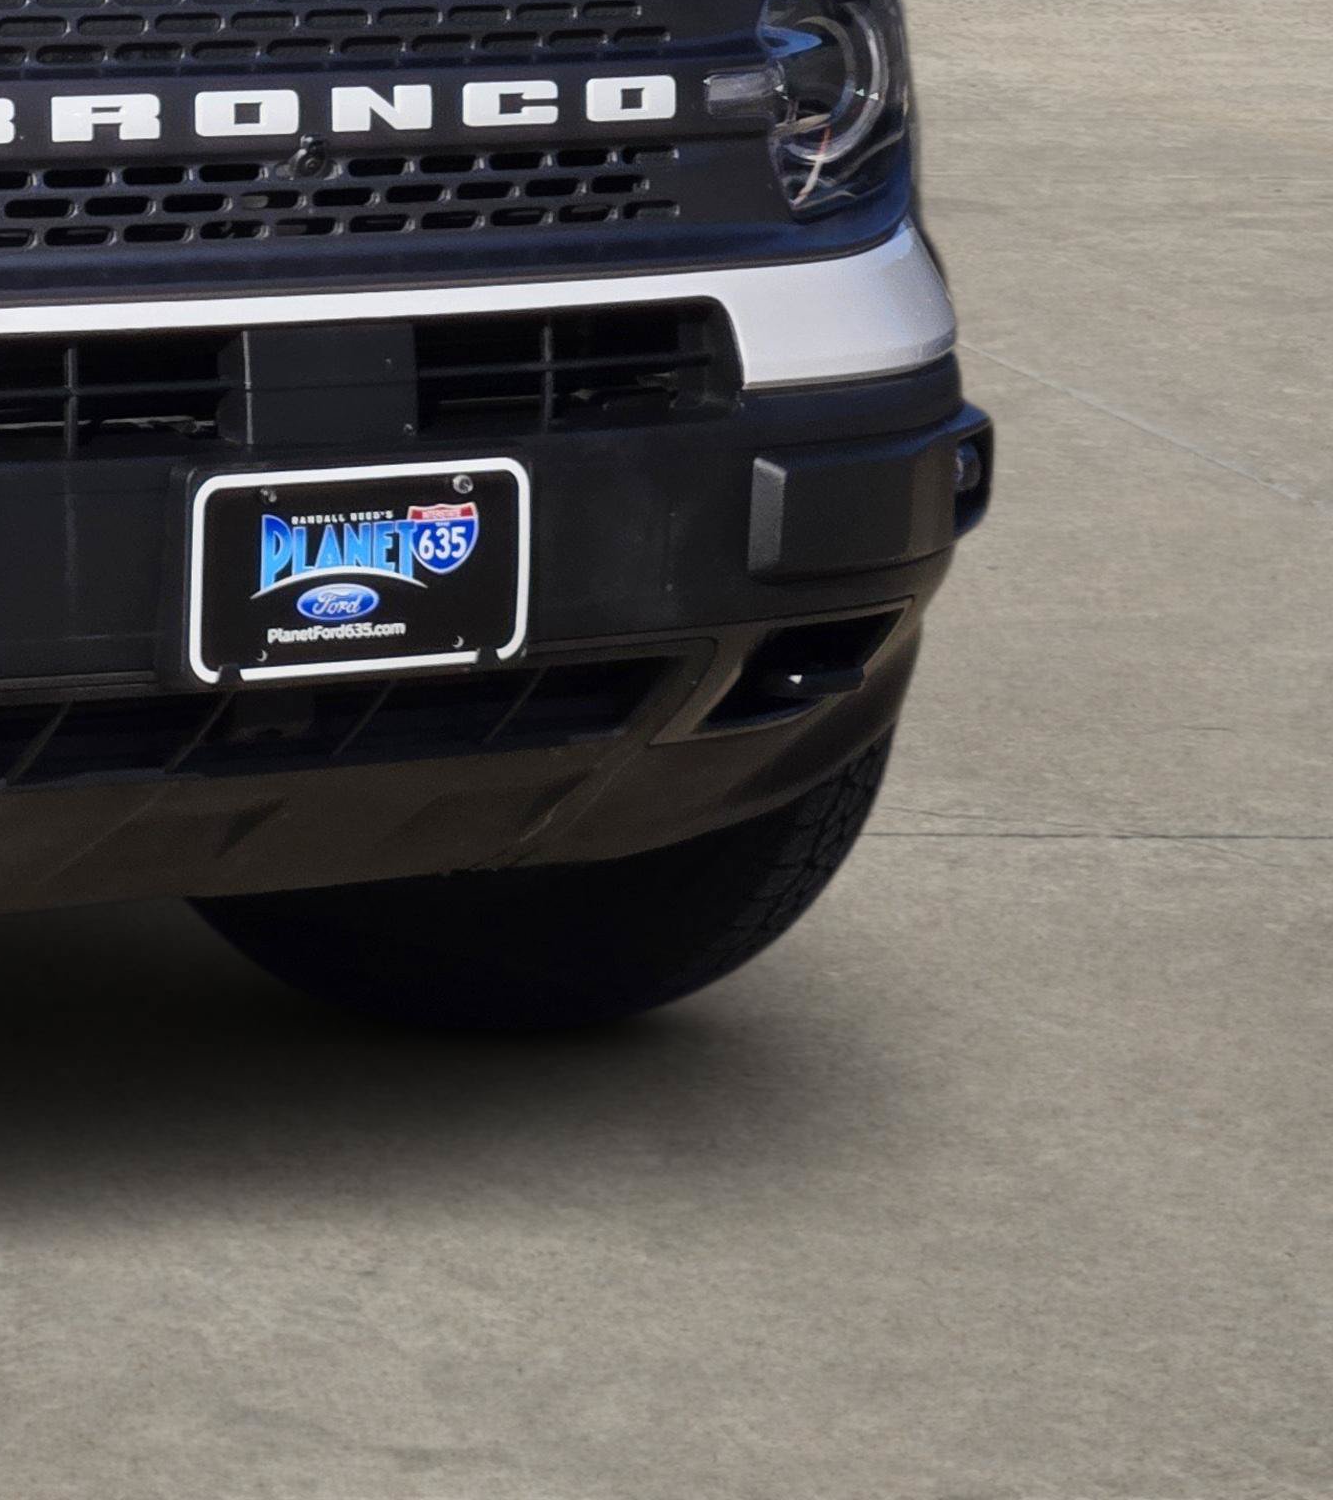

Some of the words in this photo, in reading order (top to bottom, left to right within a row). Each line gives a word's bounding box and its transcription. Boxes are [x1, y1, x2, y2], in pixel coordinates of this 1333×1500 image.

[260, 514, 418, 591] PLANET
[419, 526, 467, 560] 635
[312, 588, 362, 615] Ford
[267, 622, 407, 644] PlanetFord635.com
